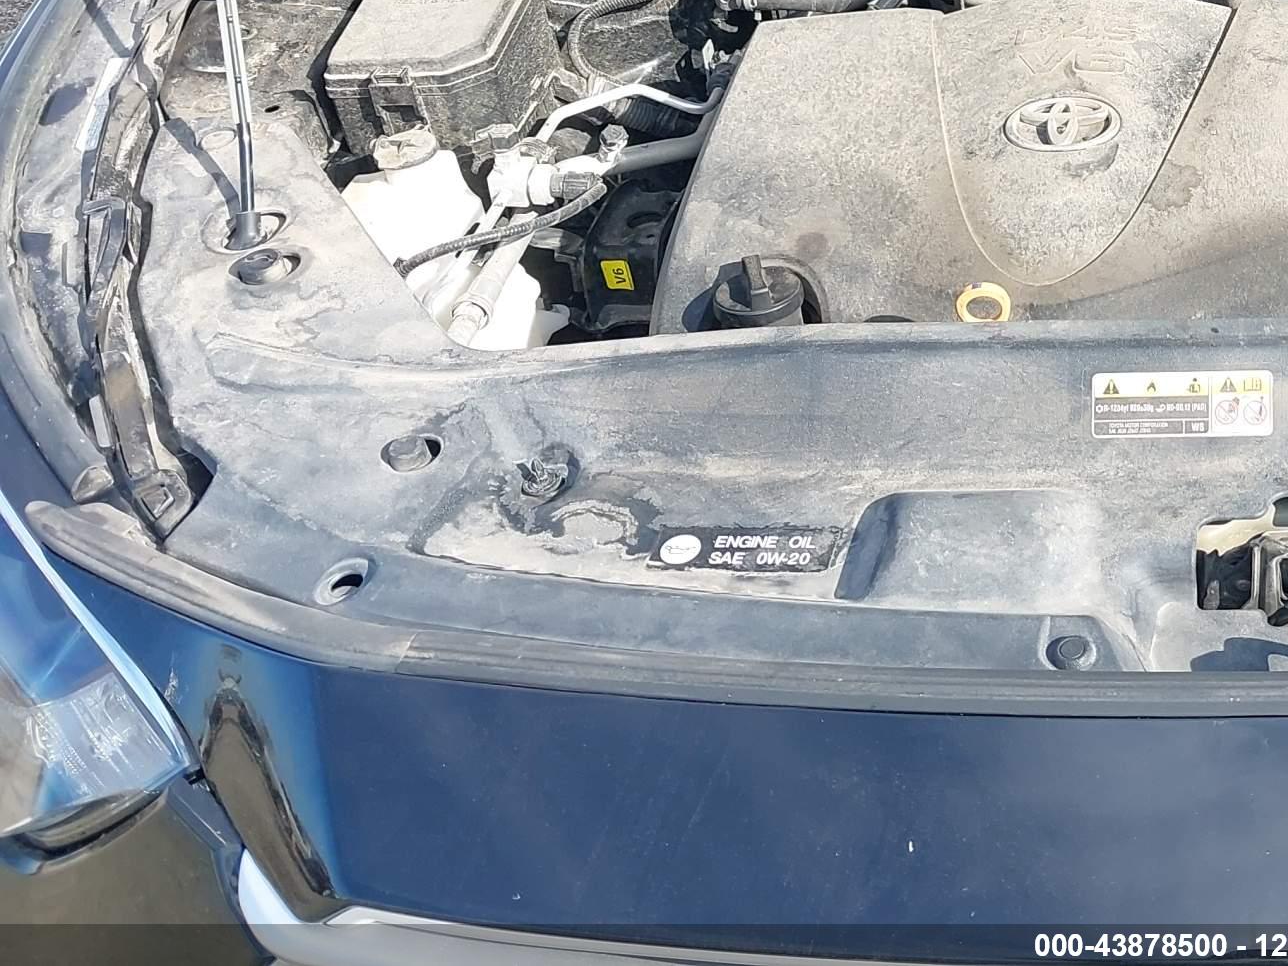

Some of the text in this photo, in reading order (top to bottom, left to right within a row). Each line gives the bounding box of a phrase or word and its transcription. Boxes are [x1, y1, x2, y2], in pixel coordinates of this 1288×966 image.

[612, 267, 626, 285] V6
[714, 535, 816, 549] ENGINE OIL
[708, 551, 811, 565] SAE 0W-20
